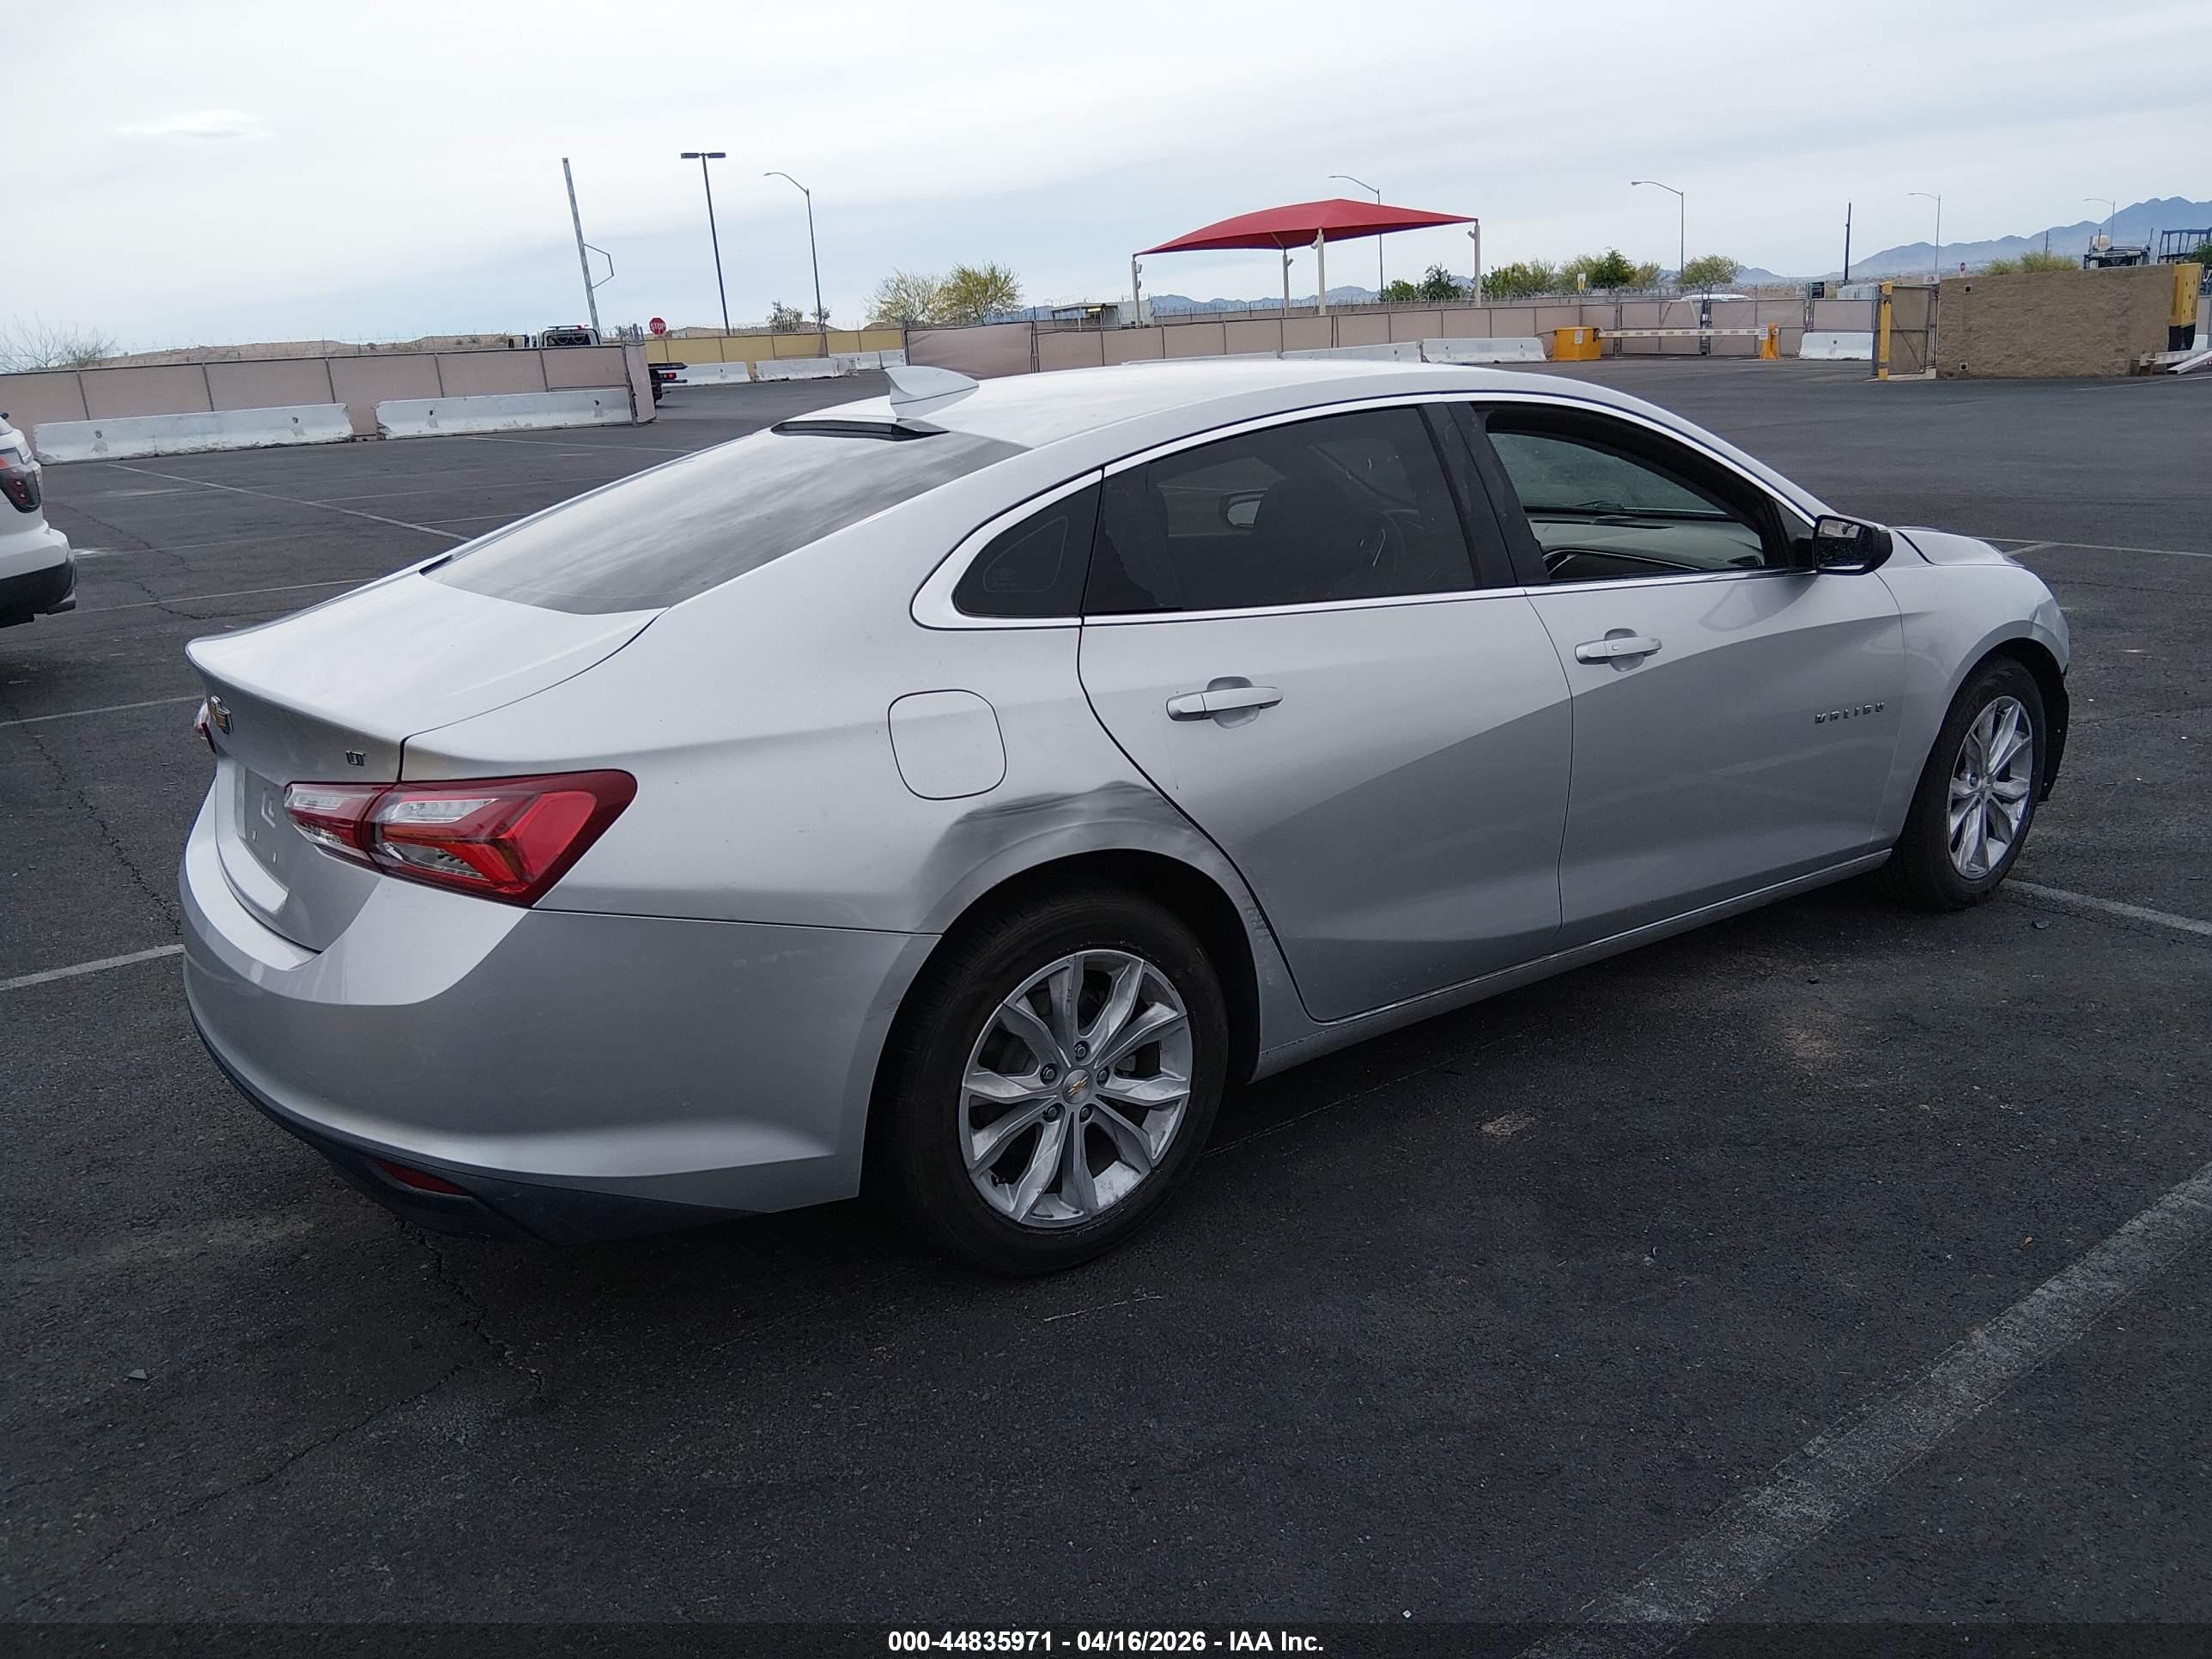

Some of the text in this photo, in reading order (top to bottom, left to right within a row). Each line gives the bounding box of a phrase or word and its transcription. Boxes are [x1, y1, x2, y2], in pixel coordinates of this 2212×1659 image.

[650, 322, 665, 331] STOP
[1814, 702, 1886, 724] MALIBU
[345, 750, 365, 766] LT
